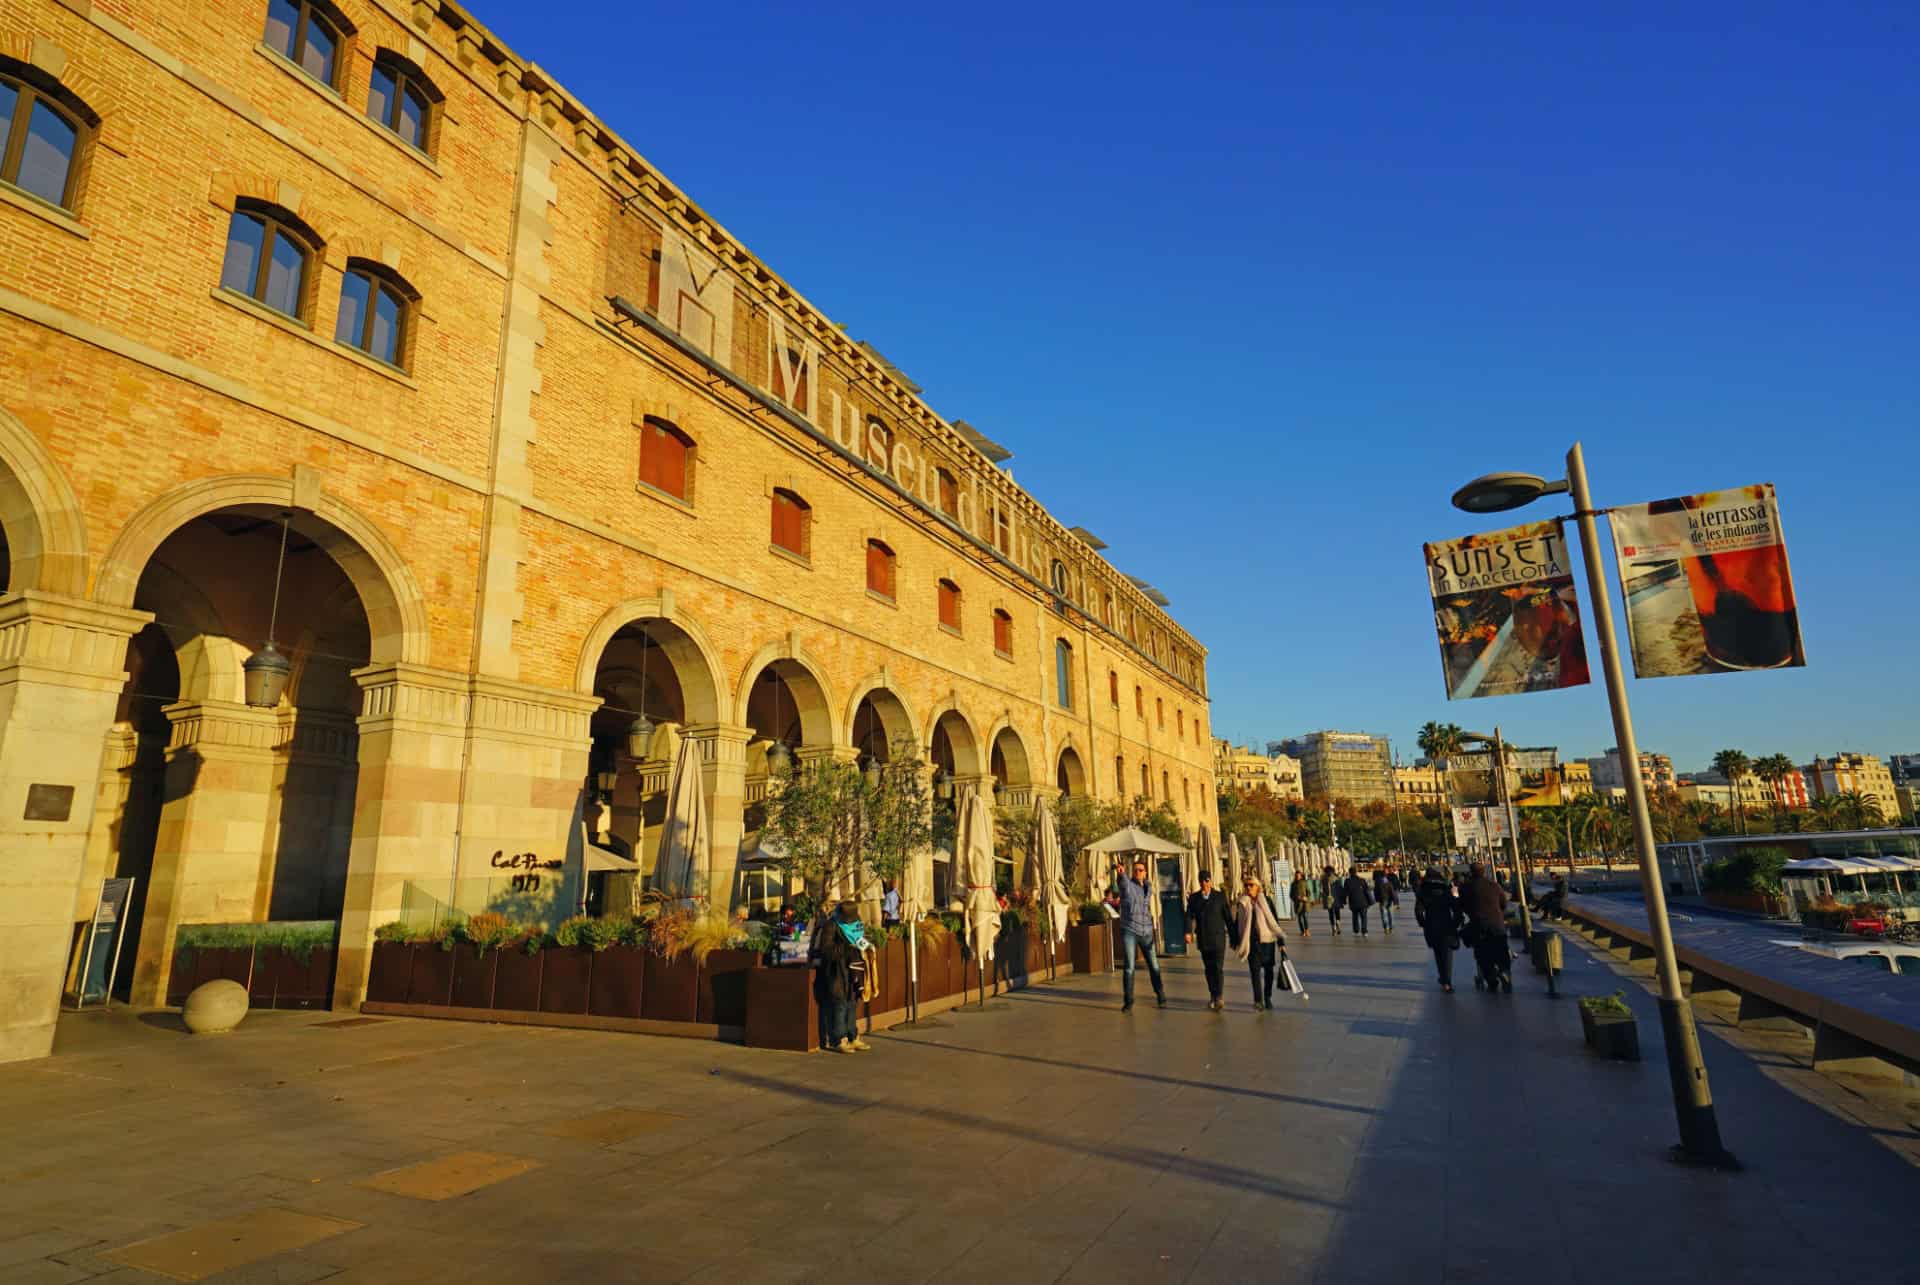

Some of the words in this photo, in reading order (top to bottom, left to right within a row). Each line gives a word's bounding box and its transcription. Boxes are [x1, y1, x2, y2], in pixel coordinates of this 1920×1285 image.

[758, 310, 944, 515] Museu
[1688, 515, 1699, 529] la
[1691, 528, 1704, 544] de
[1705, 527, 1721, 541] les
[1723, 521, 1770, 539] indianes
[1433, 535, 1556, 580] SUNSET
[1460, 562, 1563, 590] BARCELONA
